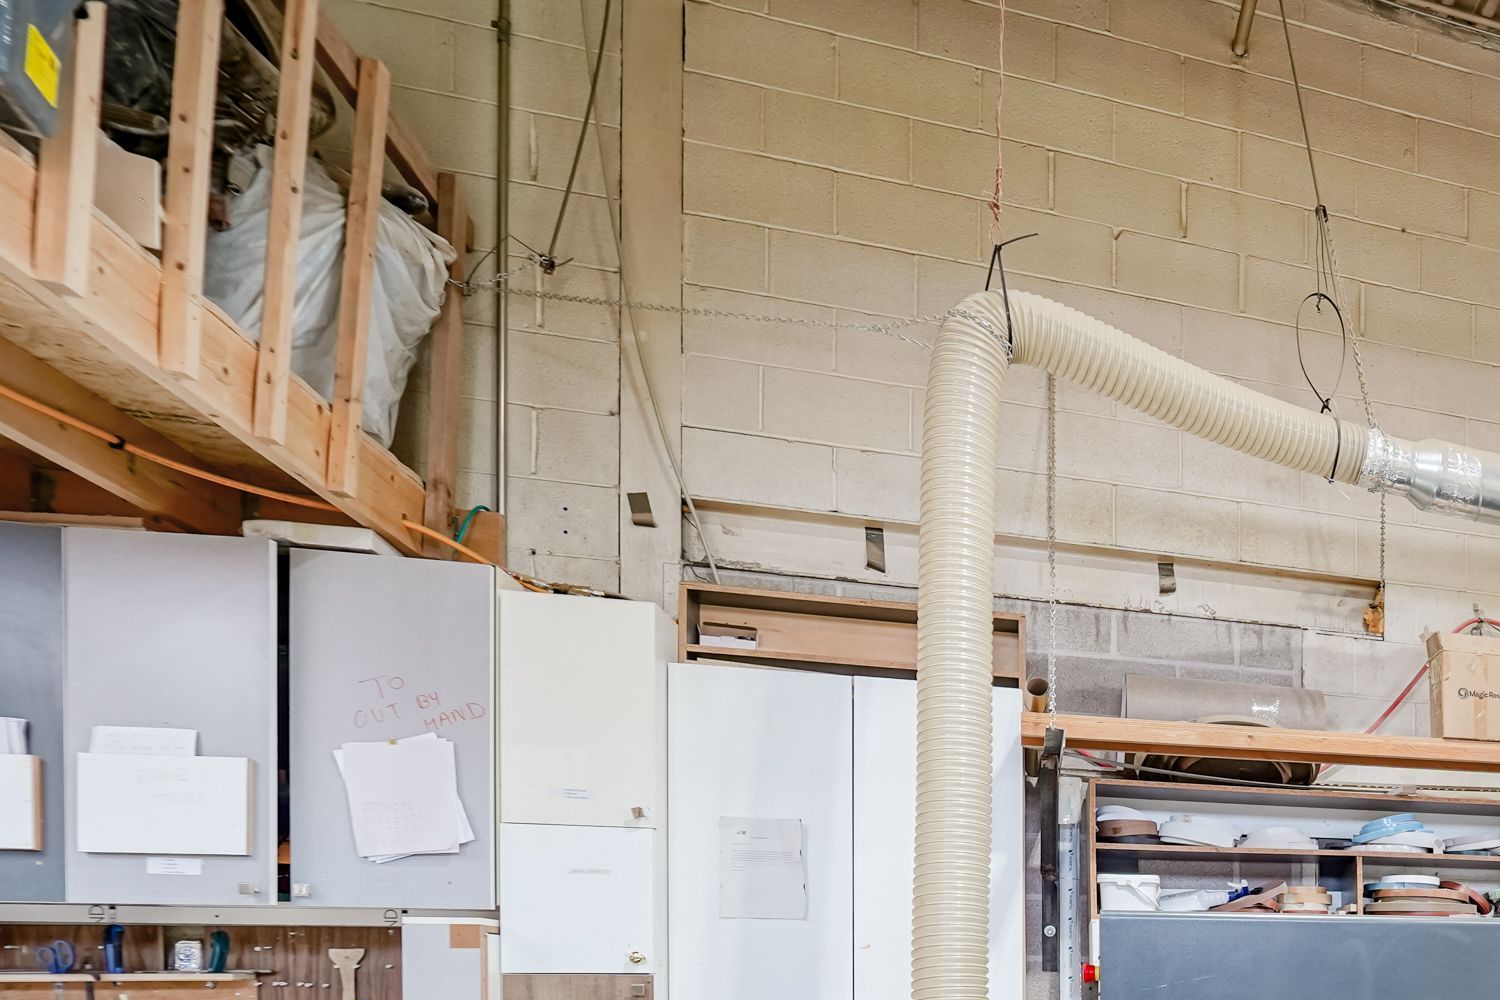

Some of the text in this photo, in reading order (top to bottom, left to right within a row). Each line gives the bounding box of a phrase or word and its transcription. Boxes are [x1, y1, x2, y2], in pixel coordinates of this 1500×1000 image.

[358, 675, 405, 698] TO
[1469, 690, 1488, 700] Magic
[416, 691, 441, 709] BY
[423, 702, 486, 730] HAND
